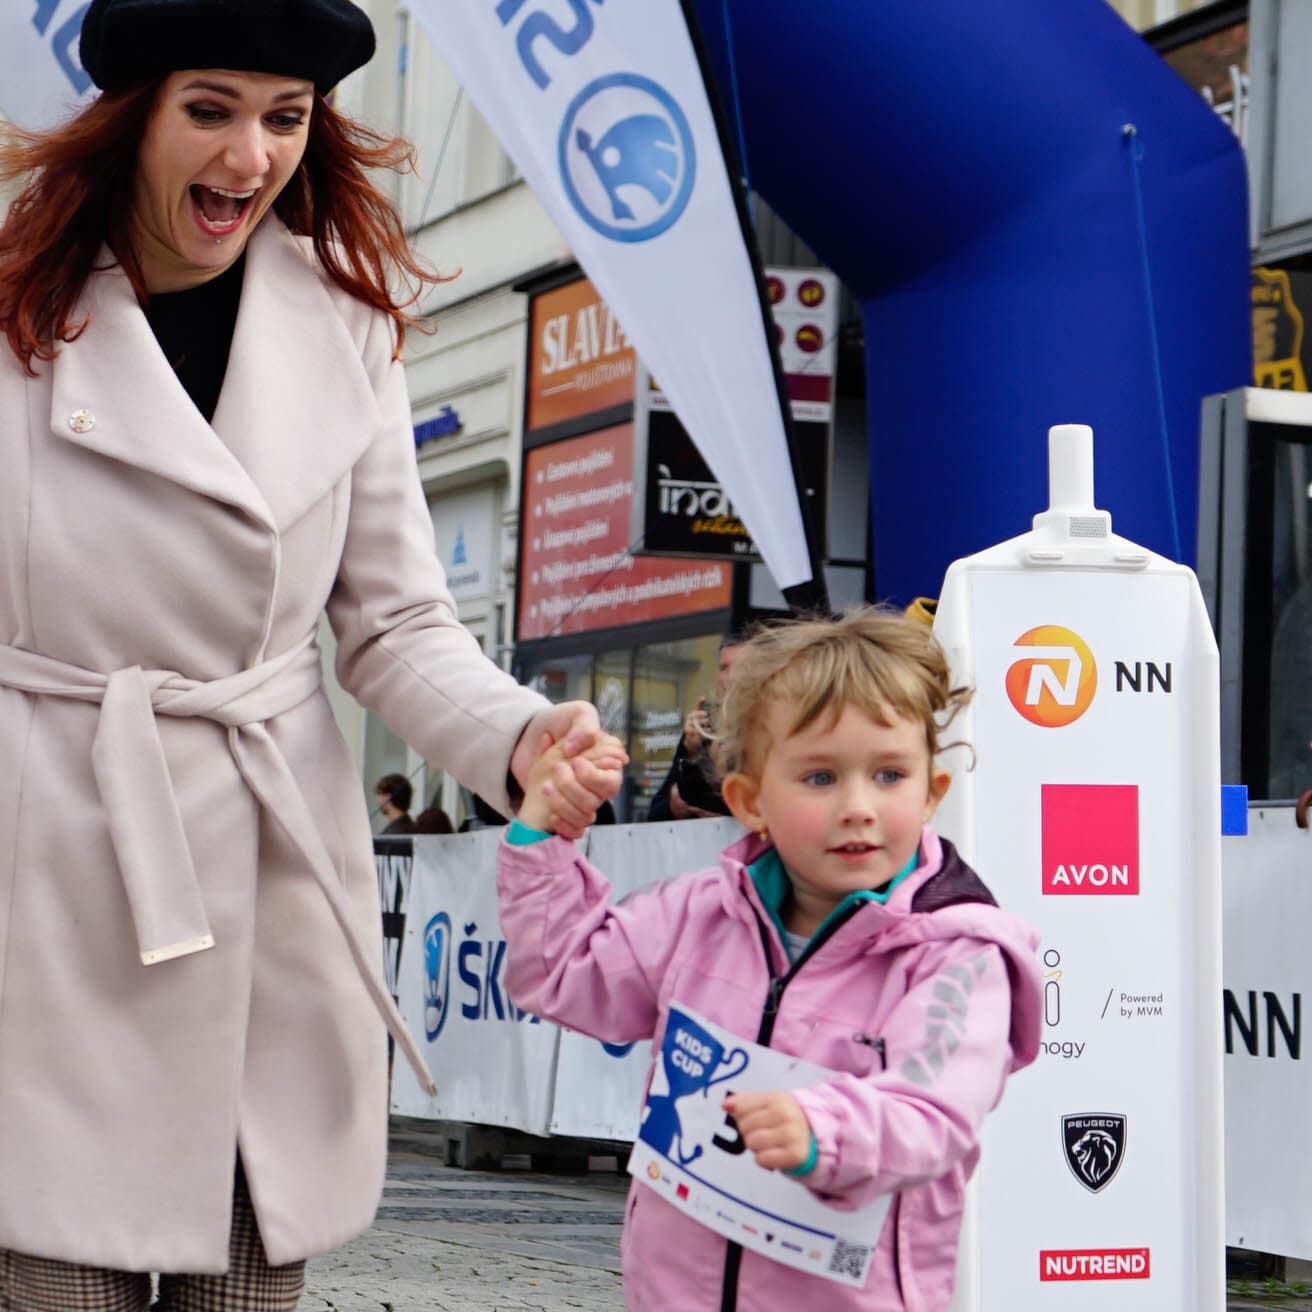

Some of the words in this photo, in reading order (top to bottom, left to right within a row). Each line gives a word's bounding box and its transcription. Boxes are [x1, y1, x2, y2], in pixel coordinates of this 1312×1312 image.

[1114, 661, 1173, 693] NN
[1051, 864, 1129, 886] AVON
[1120, 993, 1163, 1003] Powered
[1120, 1007, 1133, 1019] by
[1137, 1007, 1163, 1016] MVM
[1223, 988, 1302, 1060] NN
[674, 1028, 713, 1065] KIDS
[1040, 1041, 1086, 1059] nogy
[671, 1049, 704, 1079] CUP
[1067, 1119, 1120, 1129] PEUGEOT
[1045, 1254, 1146, 1276] NUTREND
